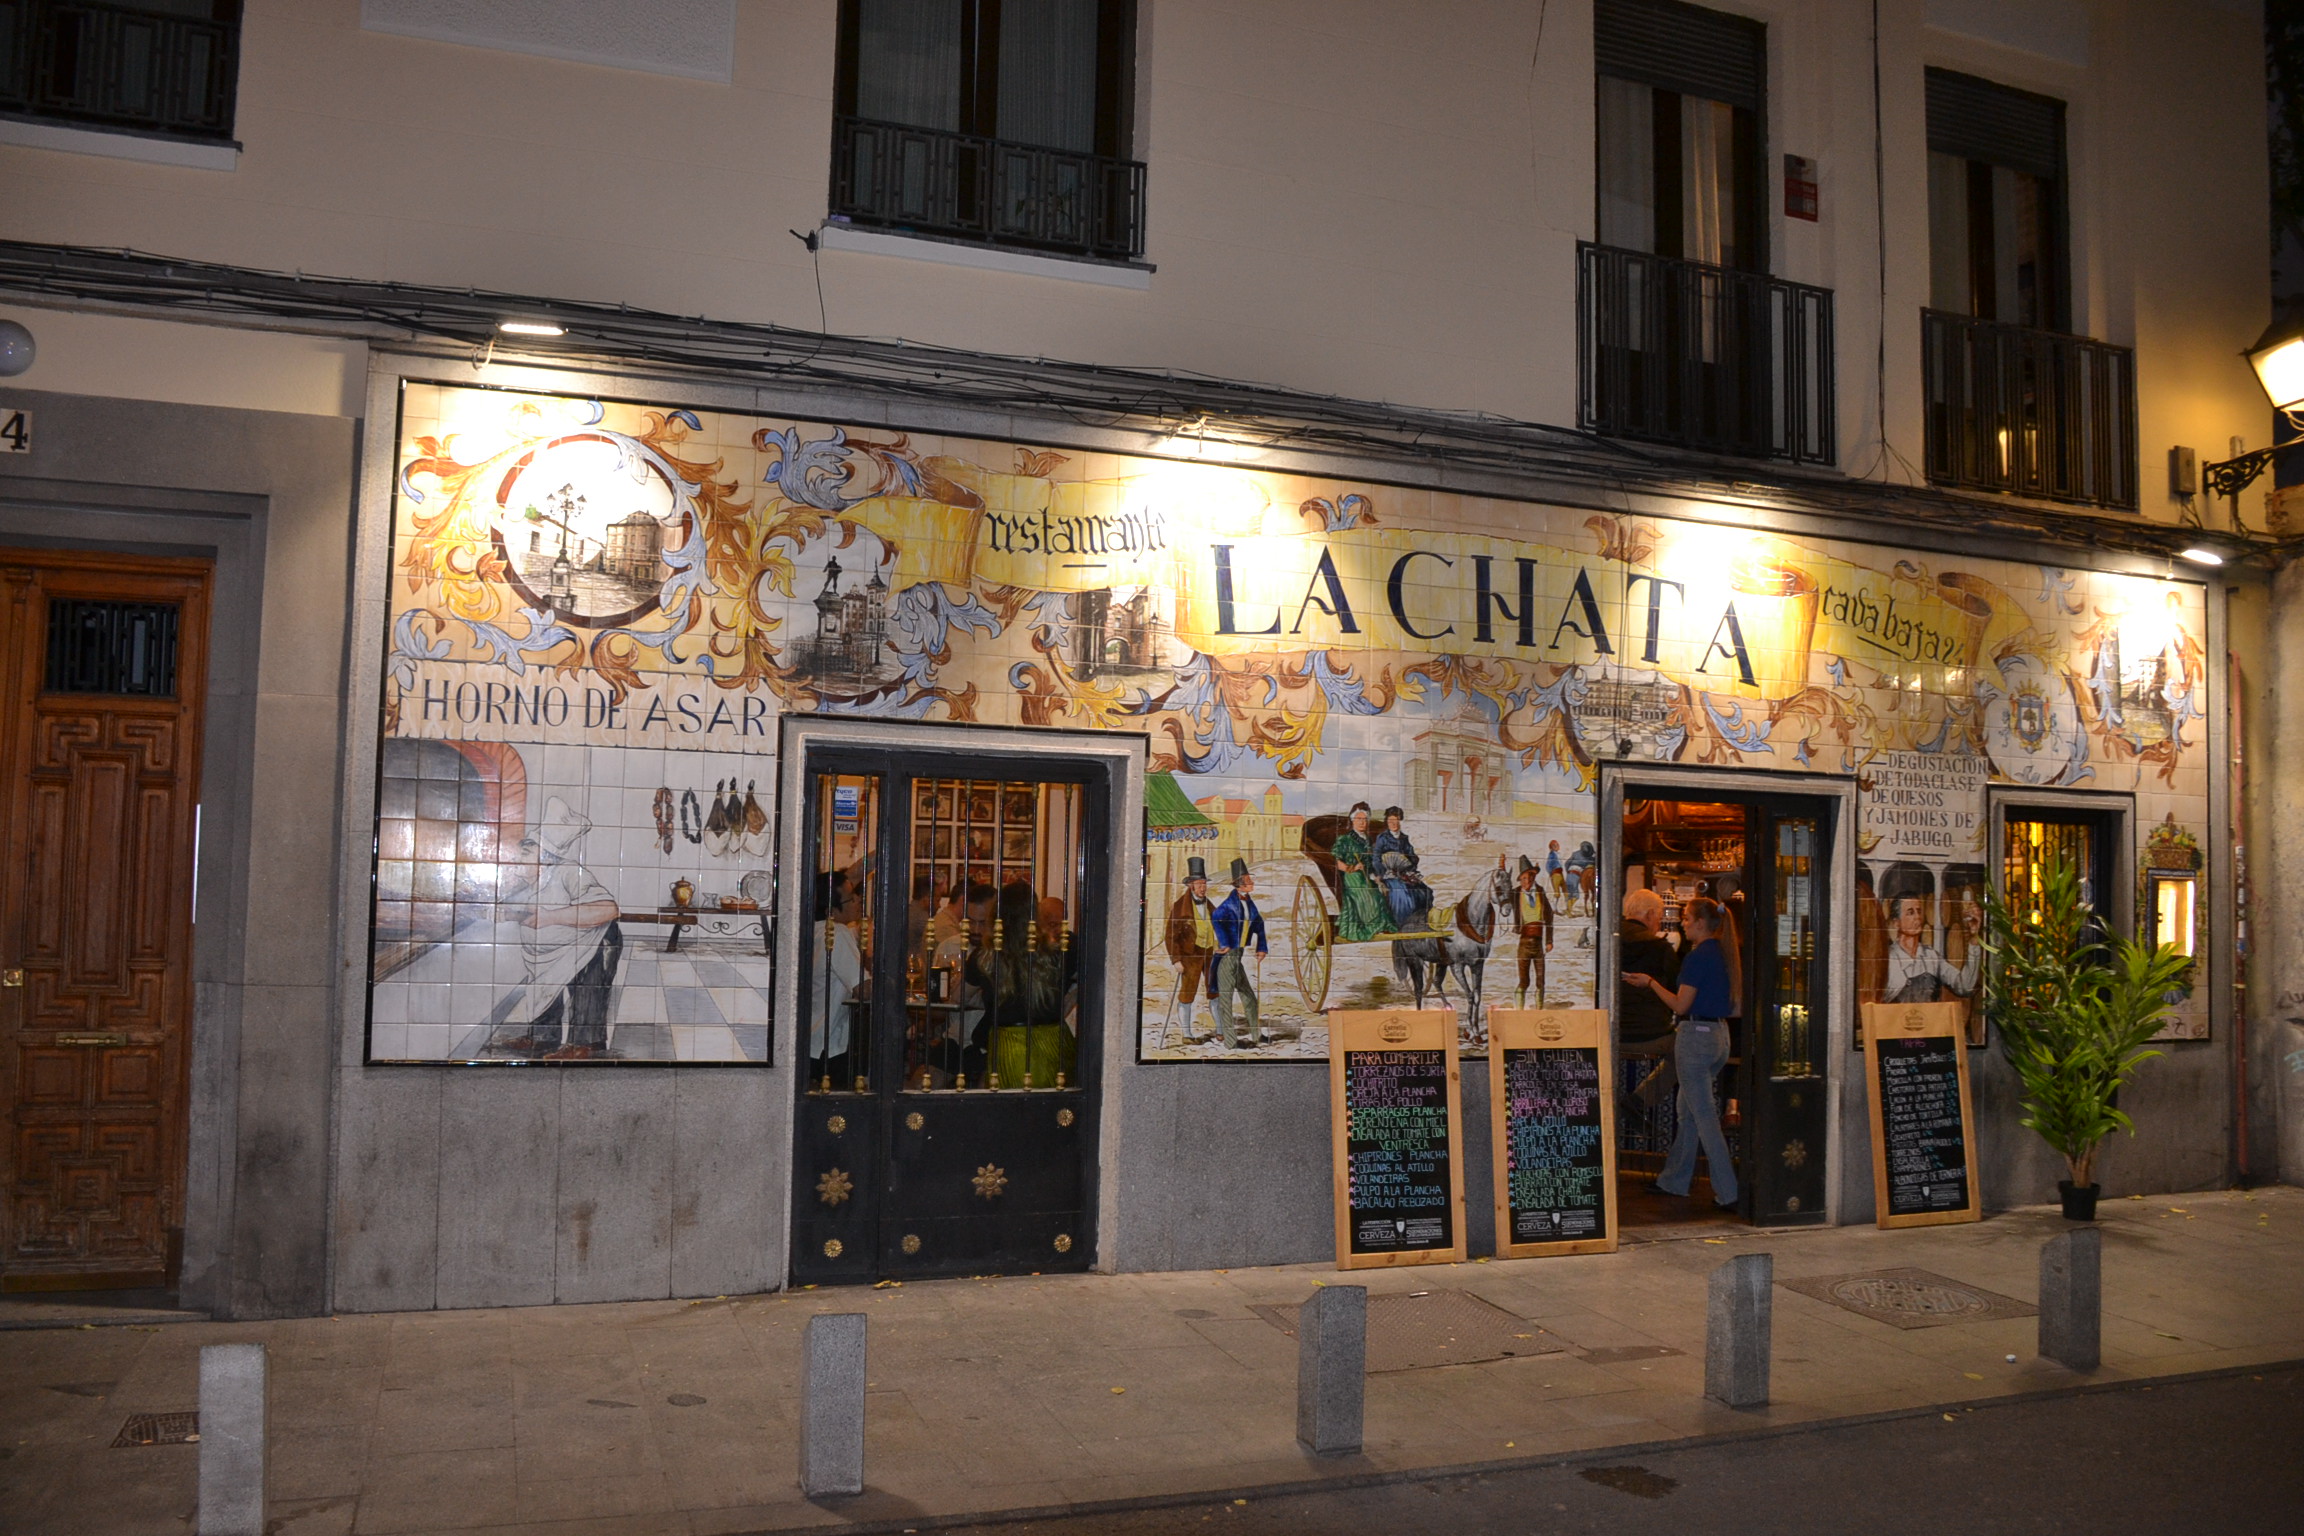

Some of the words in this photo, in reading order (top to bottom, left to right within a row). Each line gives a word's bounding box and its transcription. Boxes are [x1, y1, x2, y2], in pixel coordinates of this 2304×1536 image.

[1, 411, 29, 451] 4
[1209, 543, 1361, 635] LA
[1385, 549, 1758, 688] CHATA
[423, 678, 568, 727] HORNO
[582, 688, 628, 731] DE
[641, 692, 766, 737] ASAR
[1888, 752, 1987, 775] DEGUSTACIÓN
[1875, 770, 1893, 787] DE
[1895, 772, 1930, 790] TODA
[1931, 774, 1977, 792] CLASE
[1871, 789, 1889, 803] DE
[1891, 789, 1943, 807] QUESOS
[1864, 808, 1874, 823] Y
[1876, 809, 1948, 828] JAMONES
[1955, 813, 1974, 829] DE
[836, 823, 855, 831] VISA
[1352, 1052, 1382, 1065] PARA
[1384, 1051, 1440, 1064] COMPARTIR
[1517, 1050, 1536, 1063] SIN
[1543, 1049, 1583, 1062] GLUTEN
[1352, 1066, 1404, 1077] TORREZNOS
[1406, 1066, 1417, 1076] DE
[1382, 1089, 1387, 1097] A
[1389, 1088, 1399, 1097] LA
[1402, 1087, 1437, 1096] PLANCHA
[1382, 1098, 1395, 1107] DE
[1397, 1098, 1422, 1107] POLLO
[1412, 1107, 1447, 1116] PLANCHA
[1557, 1107, 1588, 1116] PLANCHA
[1410, 1117, 1423, 1128] CON
[1426, 1117, 1447, 1127] MIEL
[1351, 1128, 1390, 1141] ENSALADA
[1392, 1129, 1400, 1139] DE
[1403, 1128, 1430, 1139] TOMATE
[1432, 1128, 1445, 1137] CON
[1379, 1139, 1429, 1150] VENTRESCA
[1539, 1137, 1545, 1146] A
[1548, 1137, 1558, 1146] LA
[1560, 1136, 1596, 1146] PLANCHA
[1353, 1151, 1402, 1163] CHIPIRONES
[1410, 1150, 1448, 1160] PLANCHA
[1550, 1147, 1559, 1157] AL
[1354, 1163, 1392, 1174] COQUINAS
[1395, 1163, 1405, 1172] AL
[1565, 1177, 1591, 1187] TOMATE
[1354, 1186, 1380, 1196] PULPO
[1384, 1186, 1389, 1195] A
[1391, 1186, 1400, 1195] LA
[1404, 1185, 1442, 1195] PLANCHA
[1516, 1188, 1555, 1199] ENSALADA
[1558, 1187, 1582, 1197] CHATA
[1354, 1197, 1395, 1209] BACALAO
[1398, 1197, 1444, 1207] REBOZADO
[1516, 1197, 1556, 1209] ENSALADA
[1558, 1197, 1567, 1207] DE
[1570, 1195, 1597, 1205] TOMATE
[1517, 1222, 1551, 1230] CERVEZA
[1359, 1231, 1395, 1240] CERVEZA
